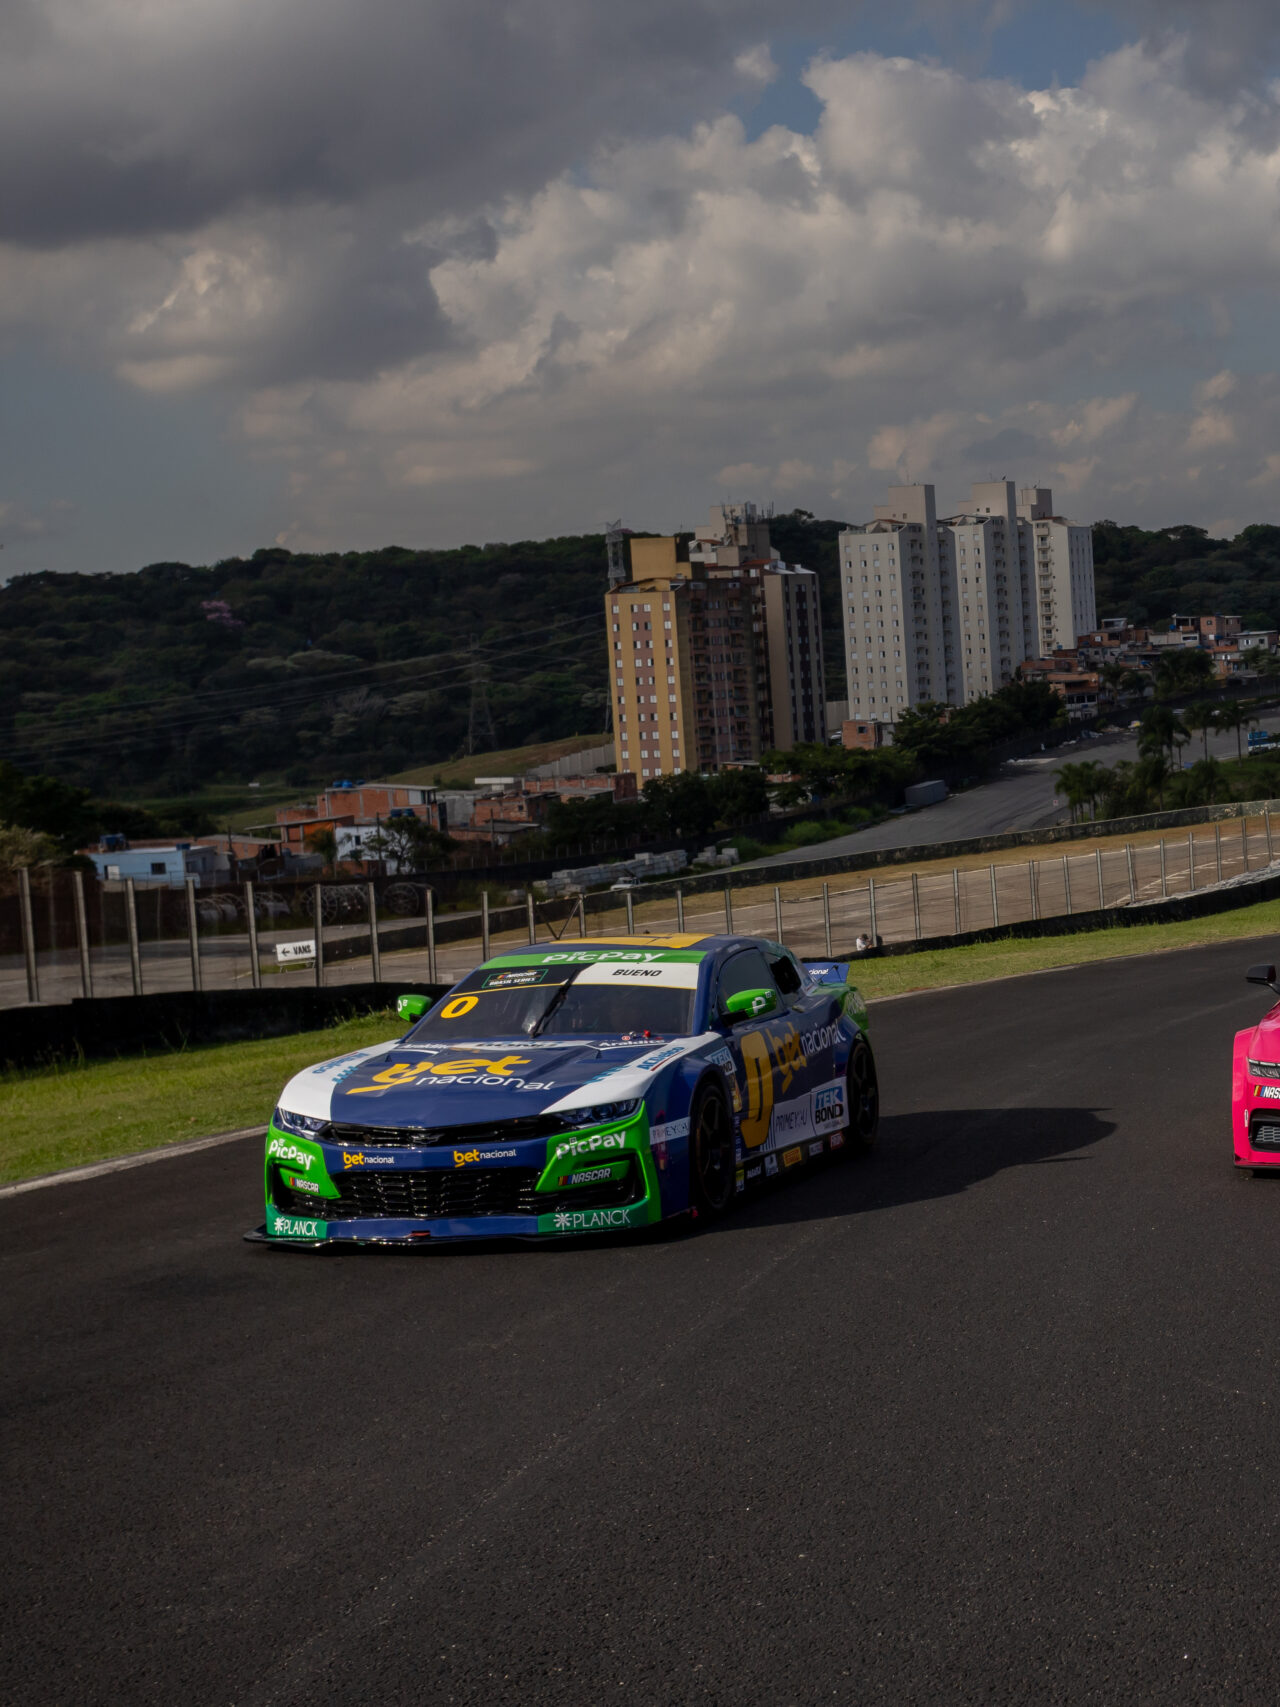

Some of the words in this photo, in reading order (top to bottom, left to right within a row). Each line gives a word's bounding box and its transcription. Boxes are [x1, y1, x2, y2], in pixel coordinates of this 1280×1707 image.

[293, 945, 312, 955] VANS
[612, 968, 663, 977] BUENO
[800, 1022, 847, 1056] nacional
[415, 1074, 554, 1091] nacional
[816, 1086, 842, 1107] TEK
[815, 1103, 845, 1124] BOND
[556, 1131, 626, 1160] PicPay
[269, 1139, 312, 1170] PicPay
[571, 1168, 611, 1183] NASCAR
[296, 1179, 319, 1193] NASCAR
[572, 1209, 631, 1227] PLANCK
[283, 1220, 317, 1236] PLANCK
